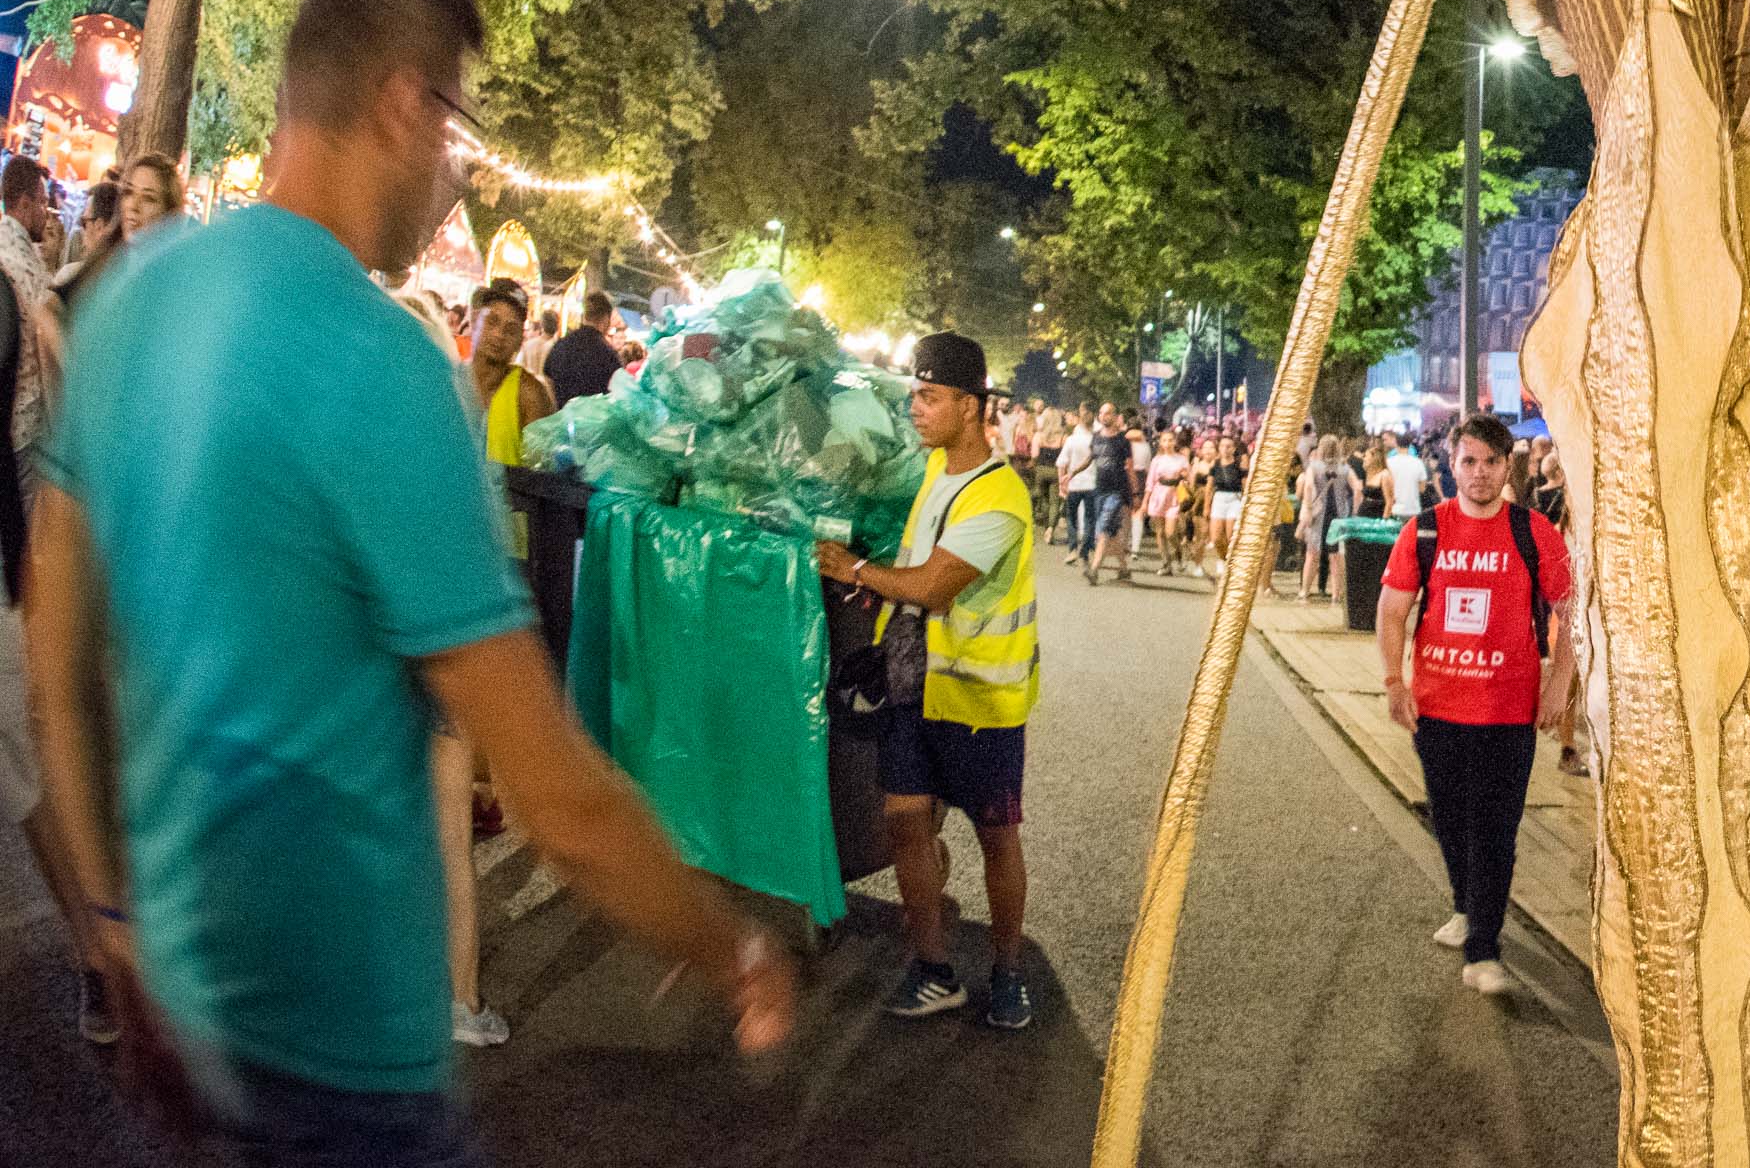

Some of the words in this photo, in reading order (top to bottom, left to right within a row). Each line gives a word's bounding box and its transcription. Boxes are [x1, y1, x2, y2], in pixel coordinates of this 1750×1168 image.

[1145, 383, 1157, 400] P
[1435, 549, 1469, 571] ASK
[1471, 551, 1499, 572] ME
[1422, 643, 1505, 666] UNTOLD
